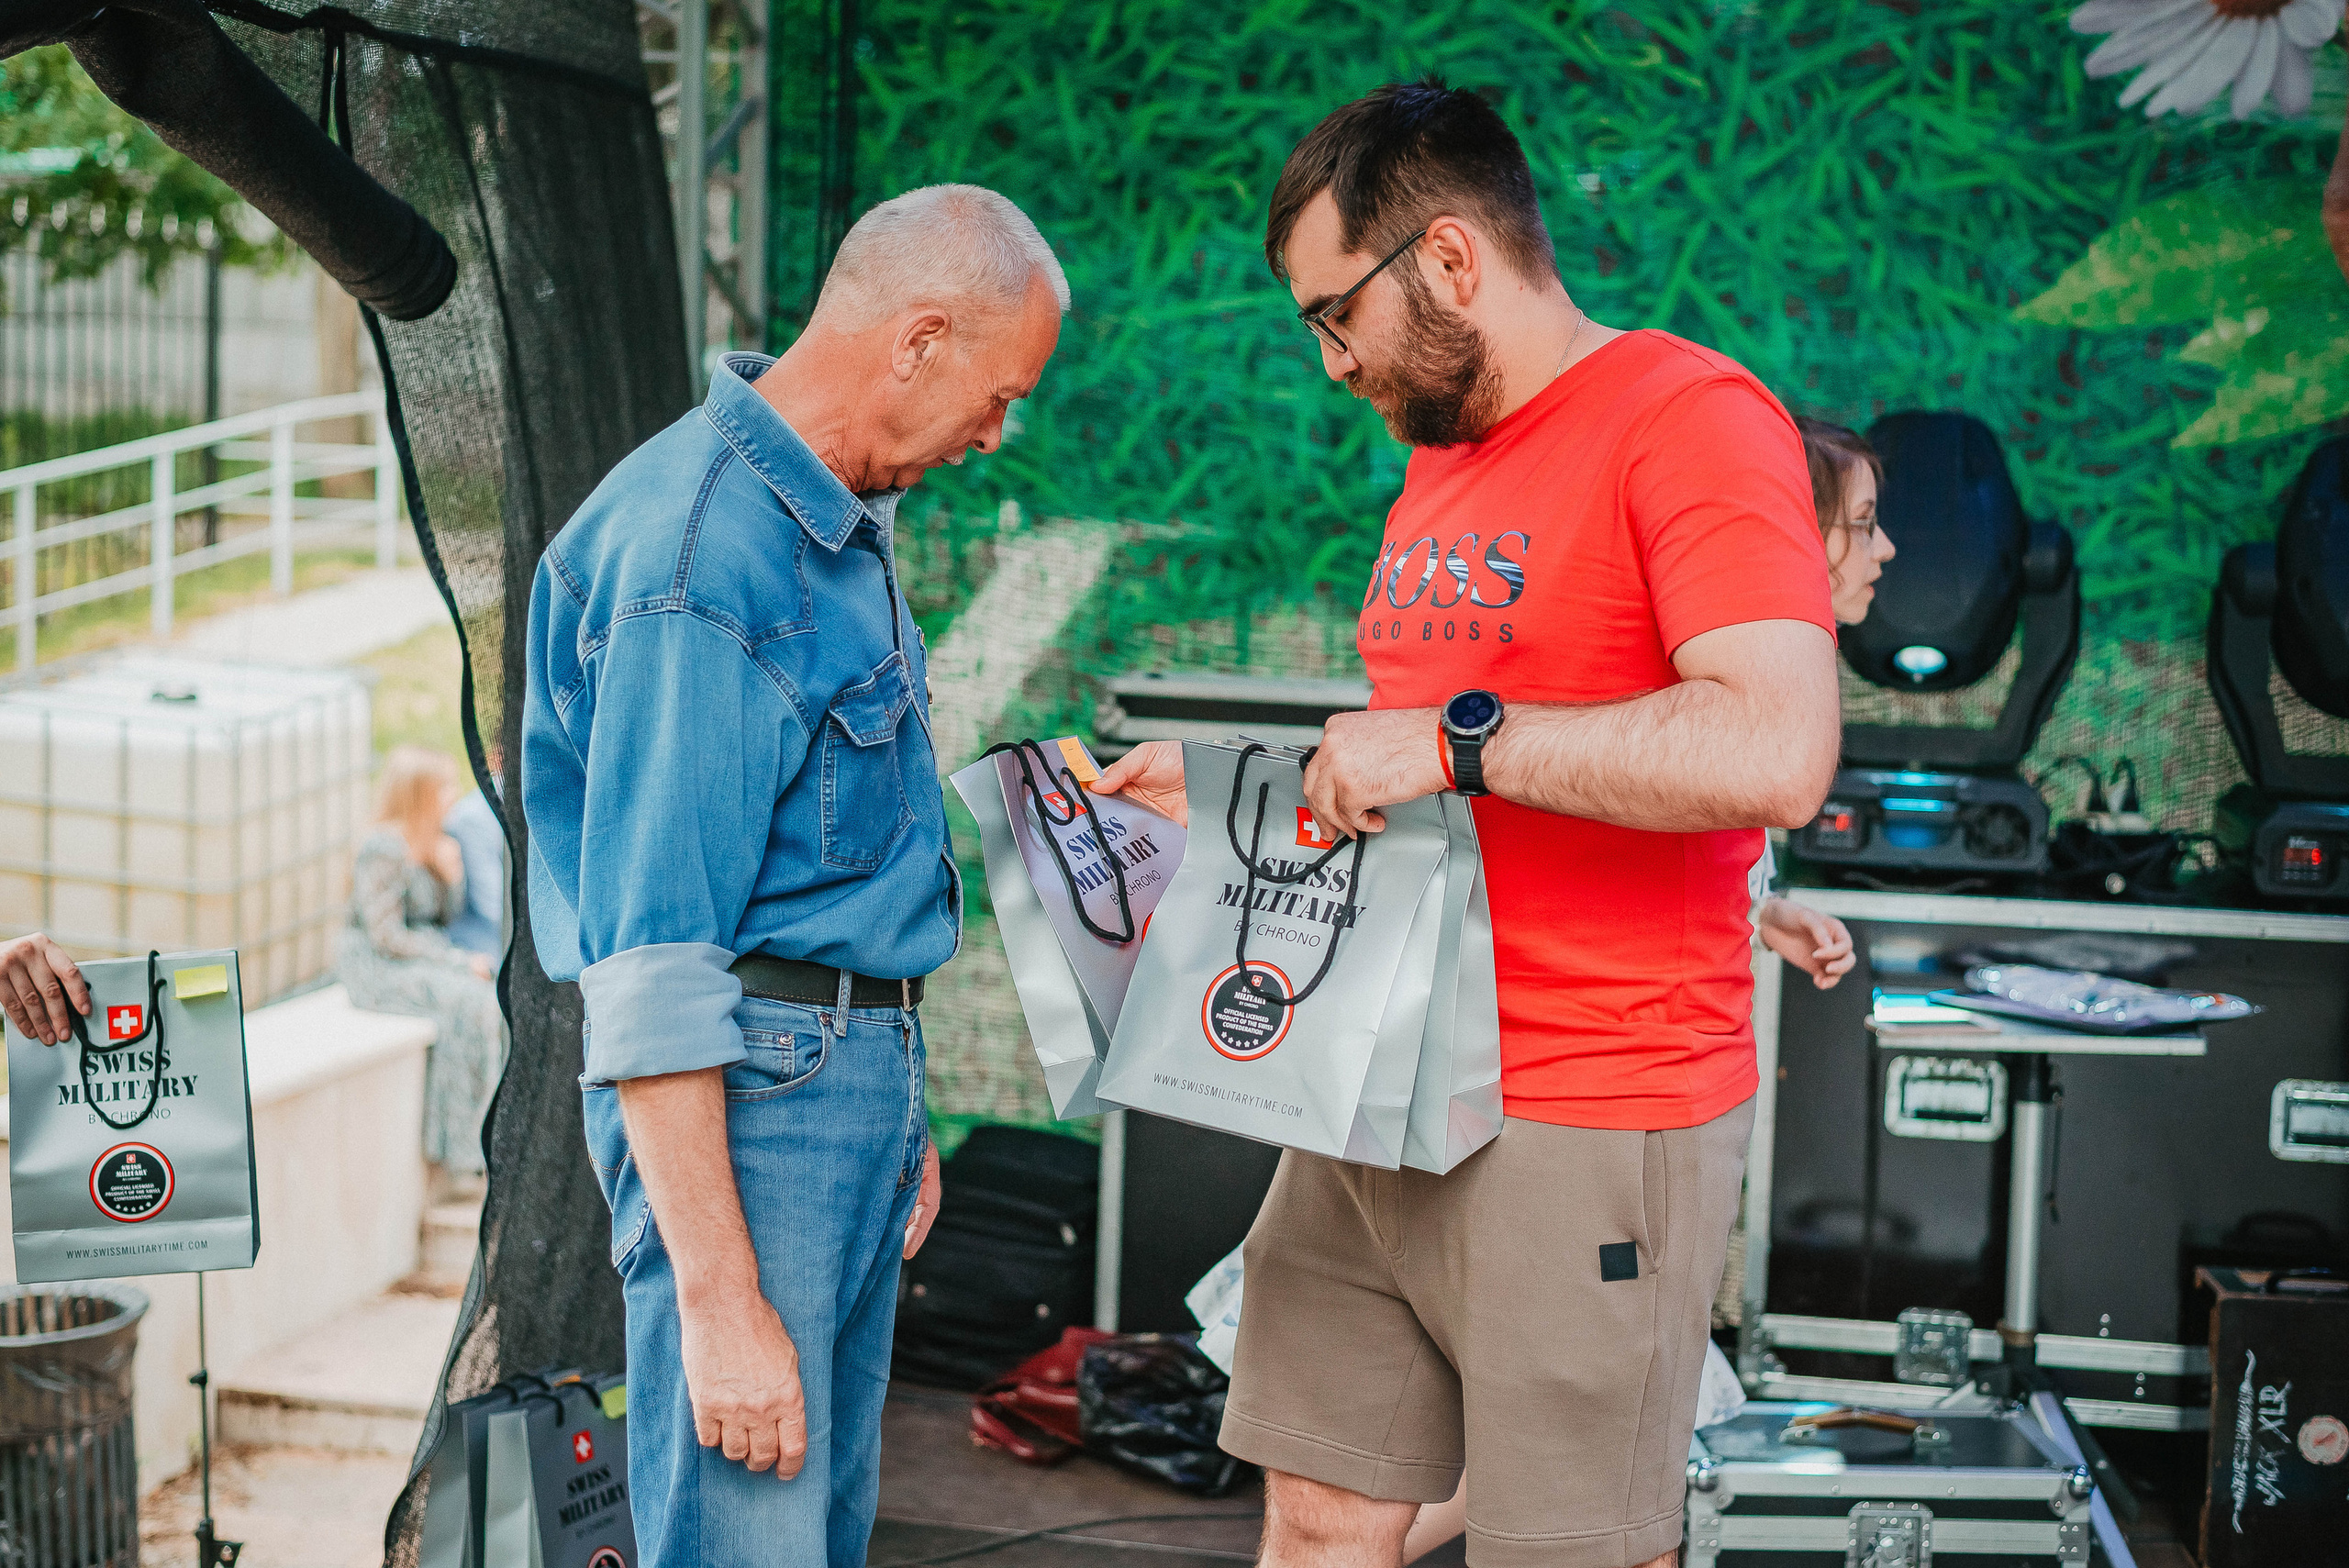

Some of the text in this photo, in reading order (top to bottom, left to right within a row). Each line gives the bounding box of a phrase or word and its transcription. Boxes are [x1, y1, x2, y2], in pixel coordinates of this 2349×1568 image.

[1359, 621, 1513, 642] UGO BOSS
[1066, 816, 1127, 861] SWSS
[1125, 870, 1161, 896] CHRONO
[1256, 923, 1320, 948] CHRONO
[1216, 1013, 1239, 1023] PRODUCT
[1258, 1021, 1274, 1031] SWISS
[1223, 1007, 1269, 1023] OFFICIAL LICENSED
[1222, 1021, 1264, 1036] CONFEDERATION
[86, 1050, 171, 1076] SWISS
[1153, 1072, 1303, 1118] WWW.SWISSMILITARYTIME.COM
[66, 1240, 208, 1260] WWW.SWISSMILITARYTIME.COM
[2257, 1380, 2293, 1444] XLR
